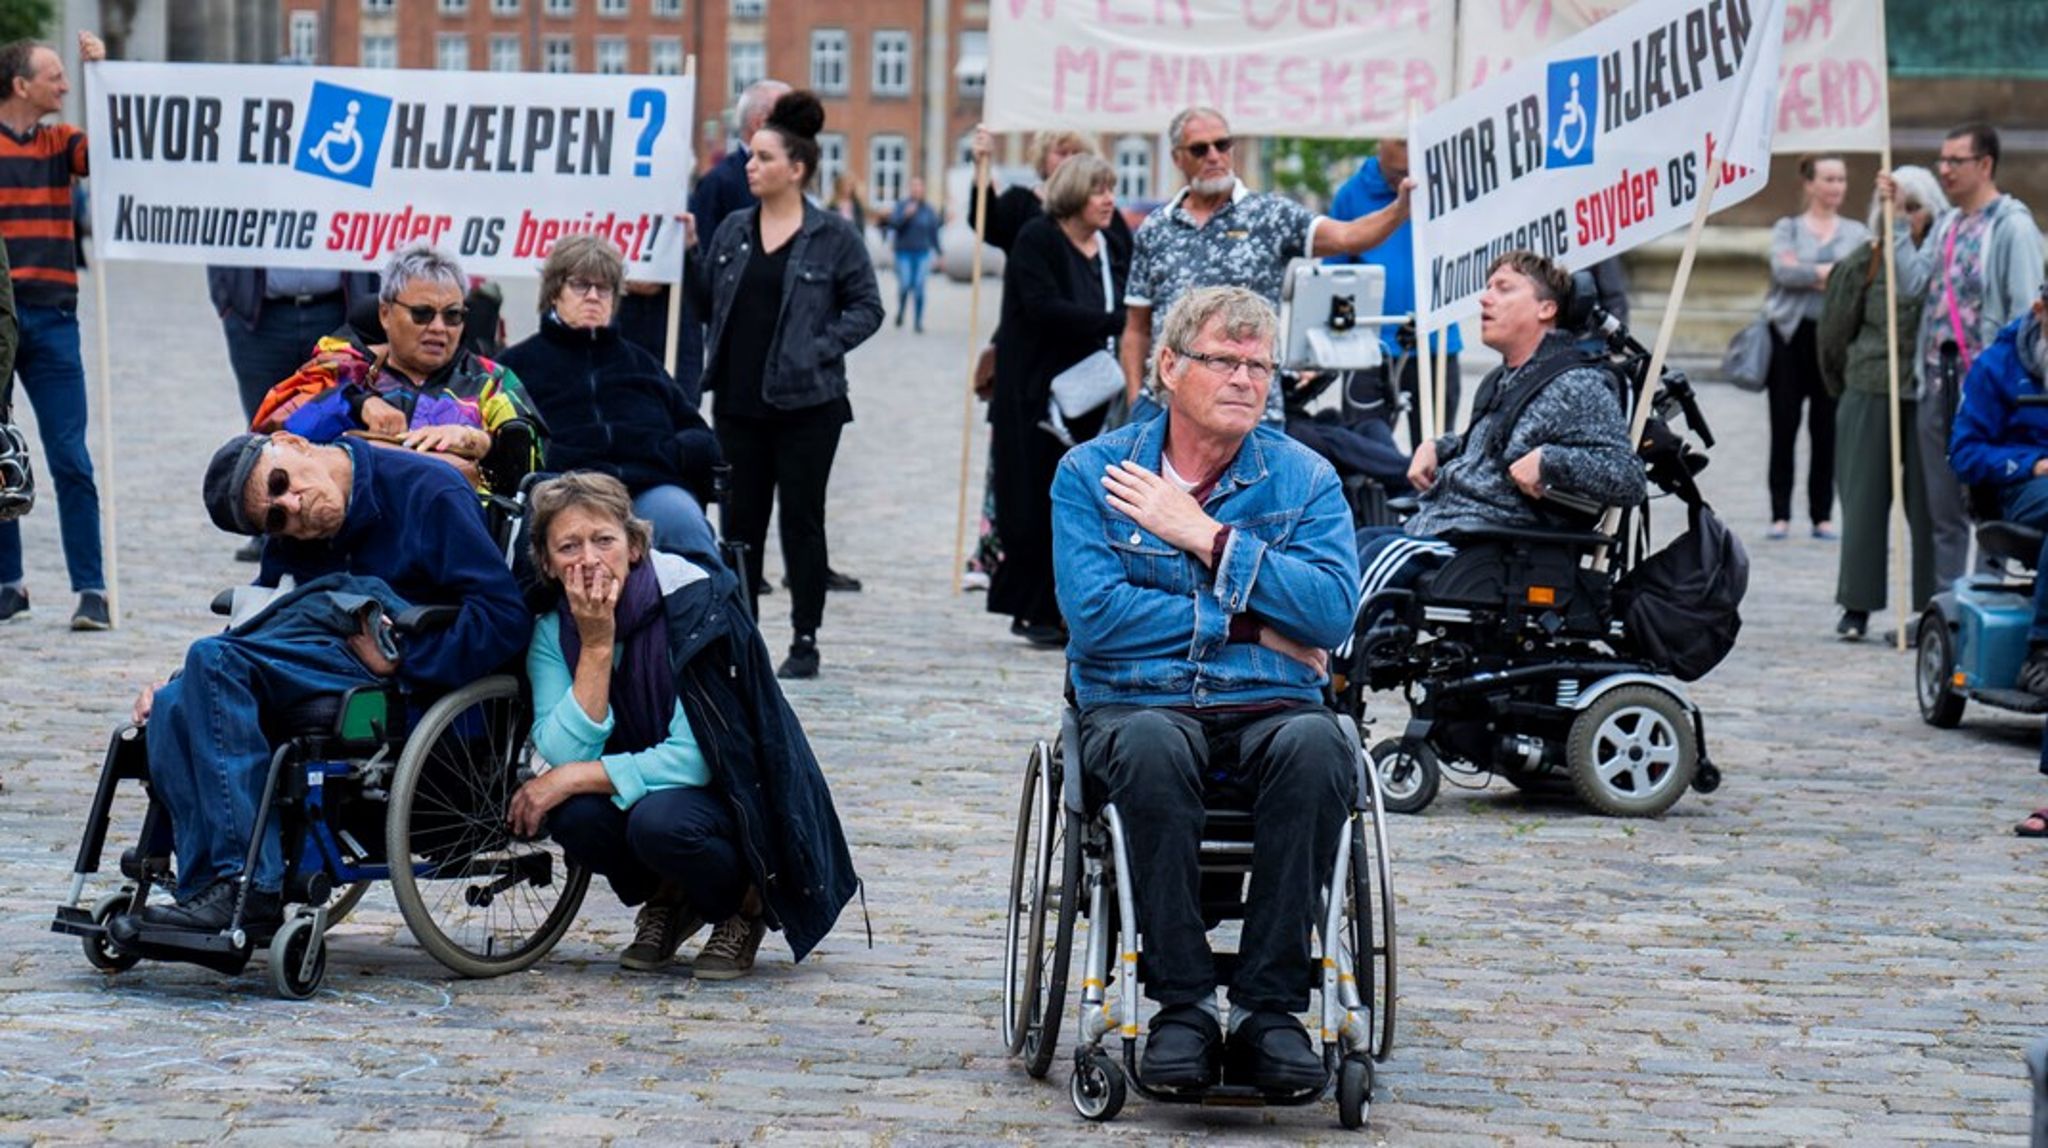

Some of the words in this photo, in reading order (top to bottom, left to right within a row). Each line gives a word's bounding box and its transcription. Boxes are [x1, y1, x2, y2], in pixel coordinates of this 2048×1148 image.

[1053, 44, 1438, 125] MENNESKER
[1425, 117, 1499, 221] HVOR
[1506, 94, 1543, 180] ER
[1602, 0, 1752, 134] HJÆLPEN
[1777, 58, 1881, 132] ÆRD
[107, 94, 222, 162] HVOR
[238, 97, 294, 164] ER
[391, 103, 614, 175] HJÆLPEN
[628, 88, 667, 177] ?
[114, 194, 318, 250] Kommunerne
[326, 205, 452, 260] snyder
[459, 216, 505, 256] os
[1575, 168, 1659, 247] snyder
[1668, 150, 1696, 207] os
